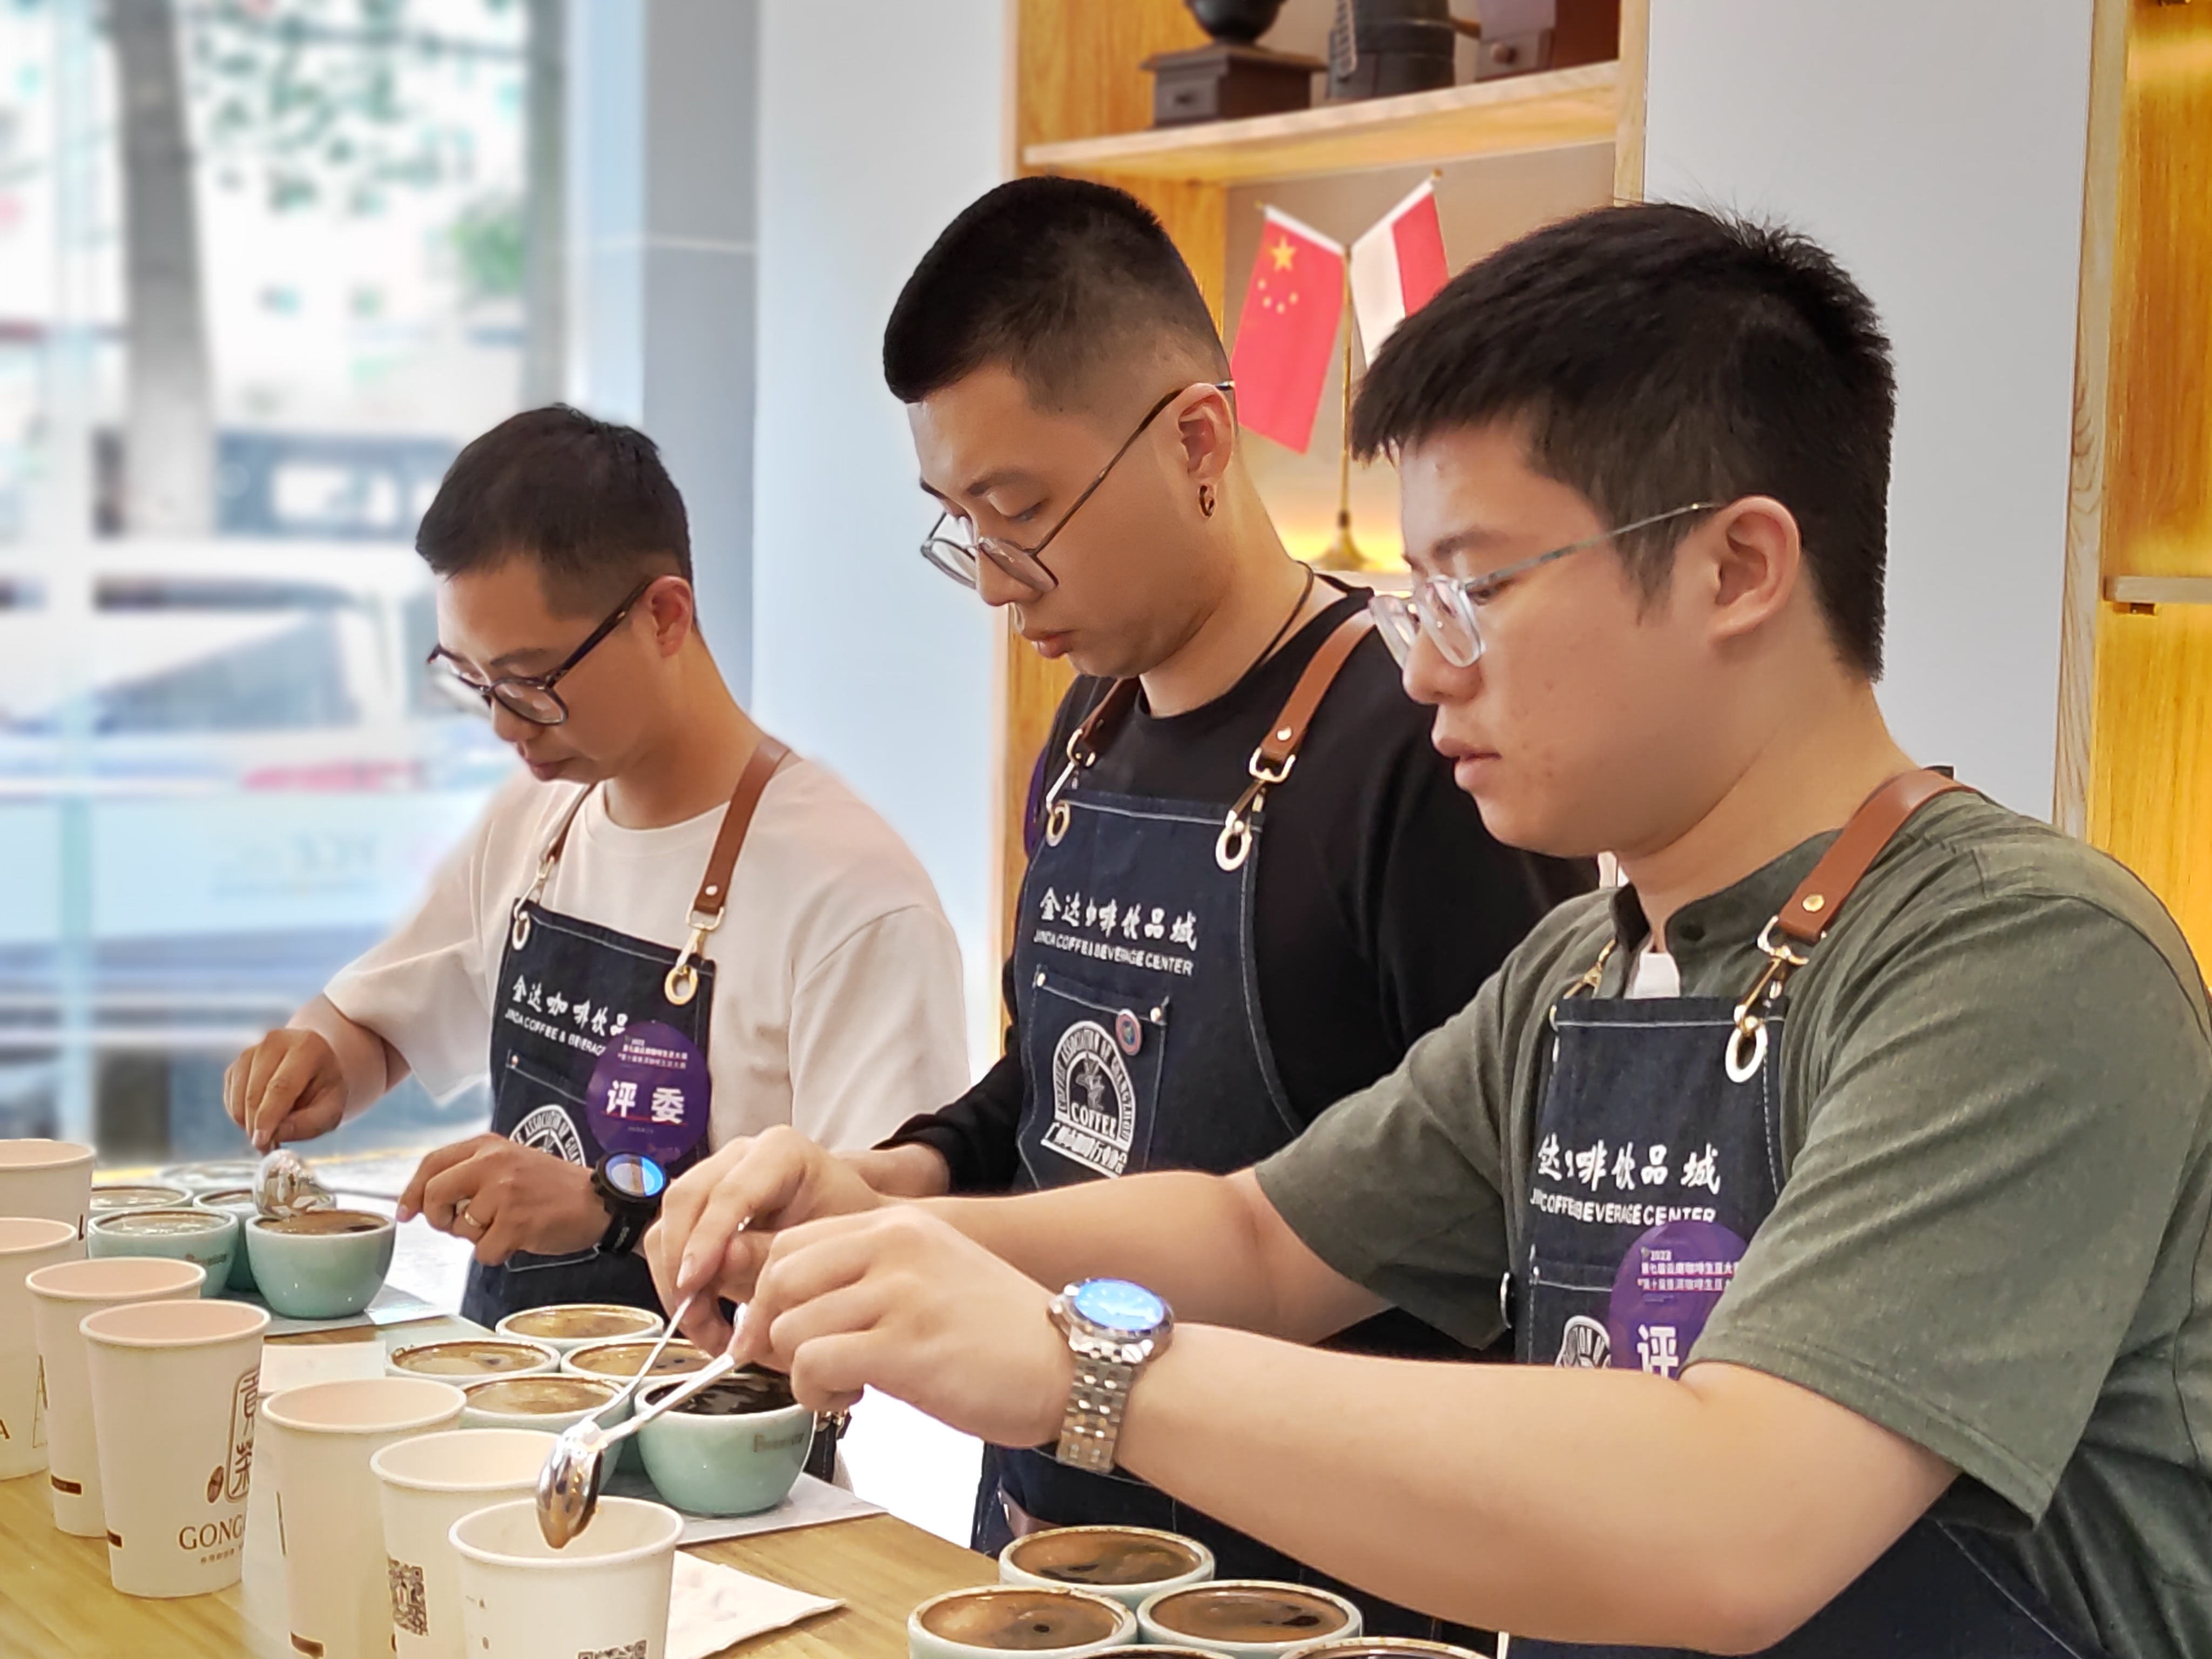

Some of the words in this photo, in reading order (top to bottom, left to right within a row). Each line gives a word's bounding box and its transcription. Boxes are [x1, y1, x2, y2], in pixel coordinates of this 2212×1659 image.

[1145, 952, 1194, 977] CENTER
[523, 1017, 558, 1041] COFFEE
[605, 1080, 685, 1124] 评委
[1071, 1102, 1117, 1140] COFFEE
[1643, 1205, 1716, 1226] CENTER
